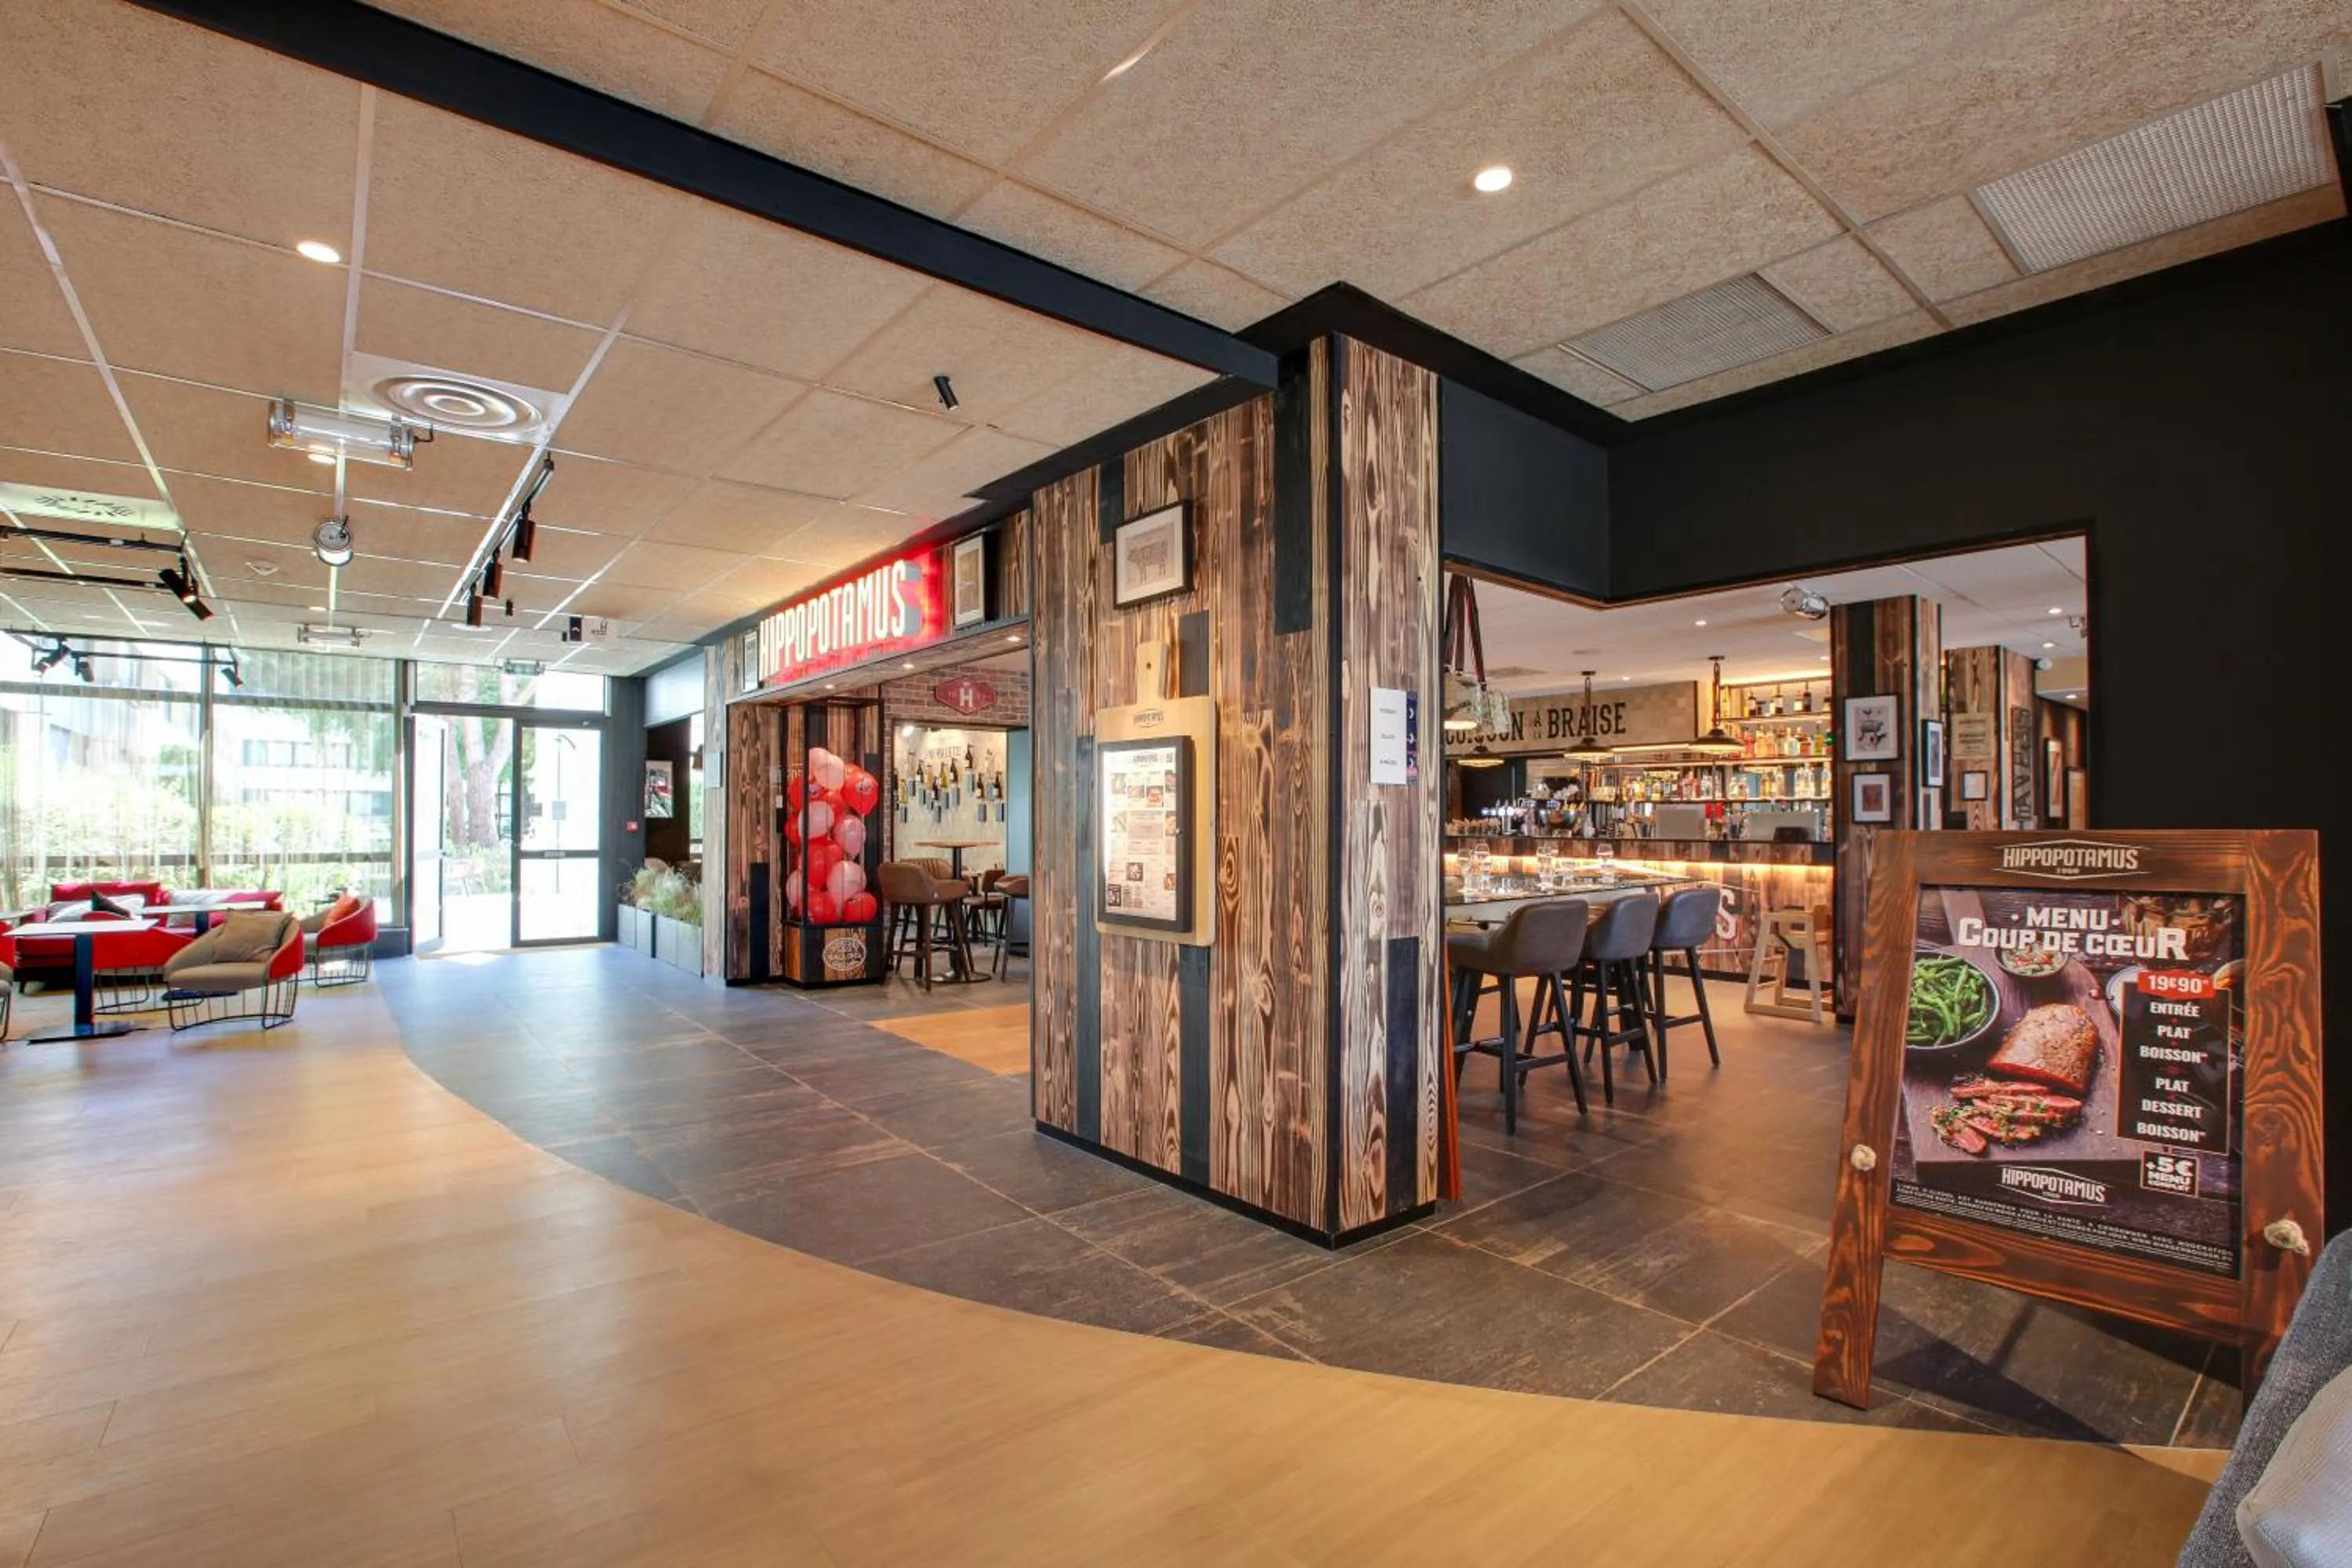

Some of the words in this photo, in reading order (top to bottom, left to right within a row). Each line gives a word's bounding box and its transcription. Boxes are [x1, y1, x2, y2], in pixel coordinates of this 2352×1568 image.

[759, 559, 907, 682] HIPPOPOTAMUS
[959, 688, 974, 708] H
[1547, 702, 1627, 739] BRAISE
[2003, 848, 2140, 869] HIPPOPOTAMUS
[2025, 906, 2109, 931] MENU
[2042, 931, 2081, 953] DE
[2149, 1001, 2201, 1018] ENTRÉE
[2157, 1025, 2192, 1039] PLAT
[2155, 1076, 2191, 1093] PLAT
[2141, 1098, 2204, 1119] DESSERT
[2002, 1167, 2106, 1203] HIPPOPOTAMUS
